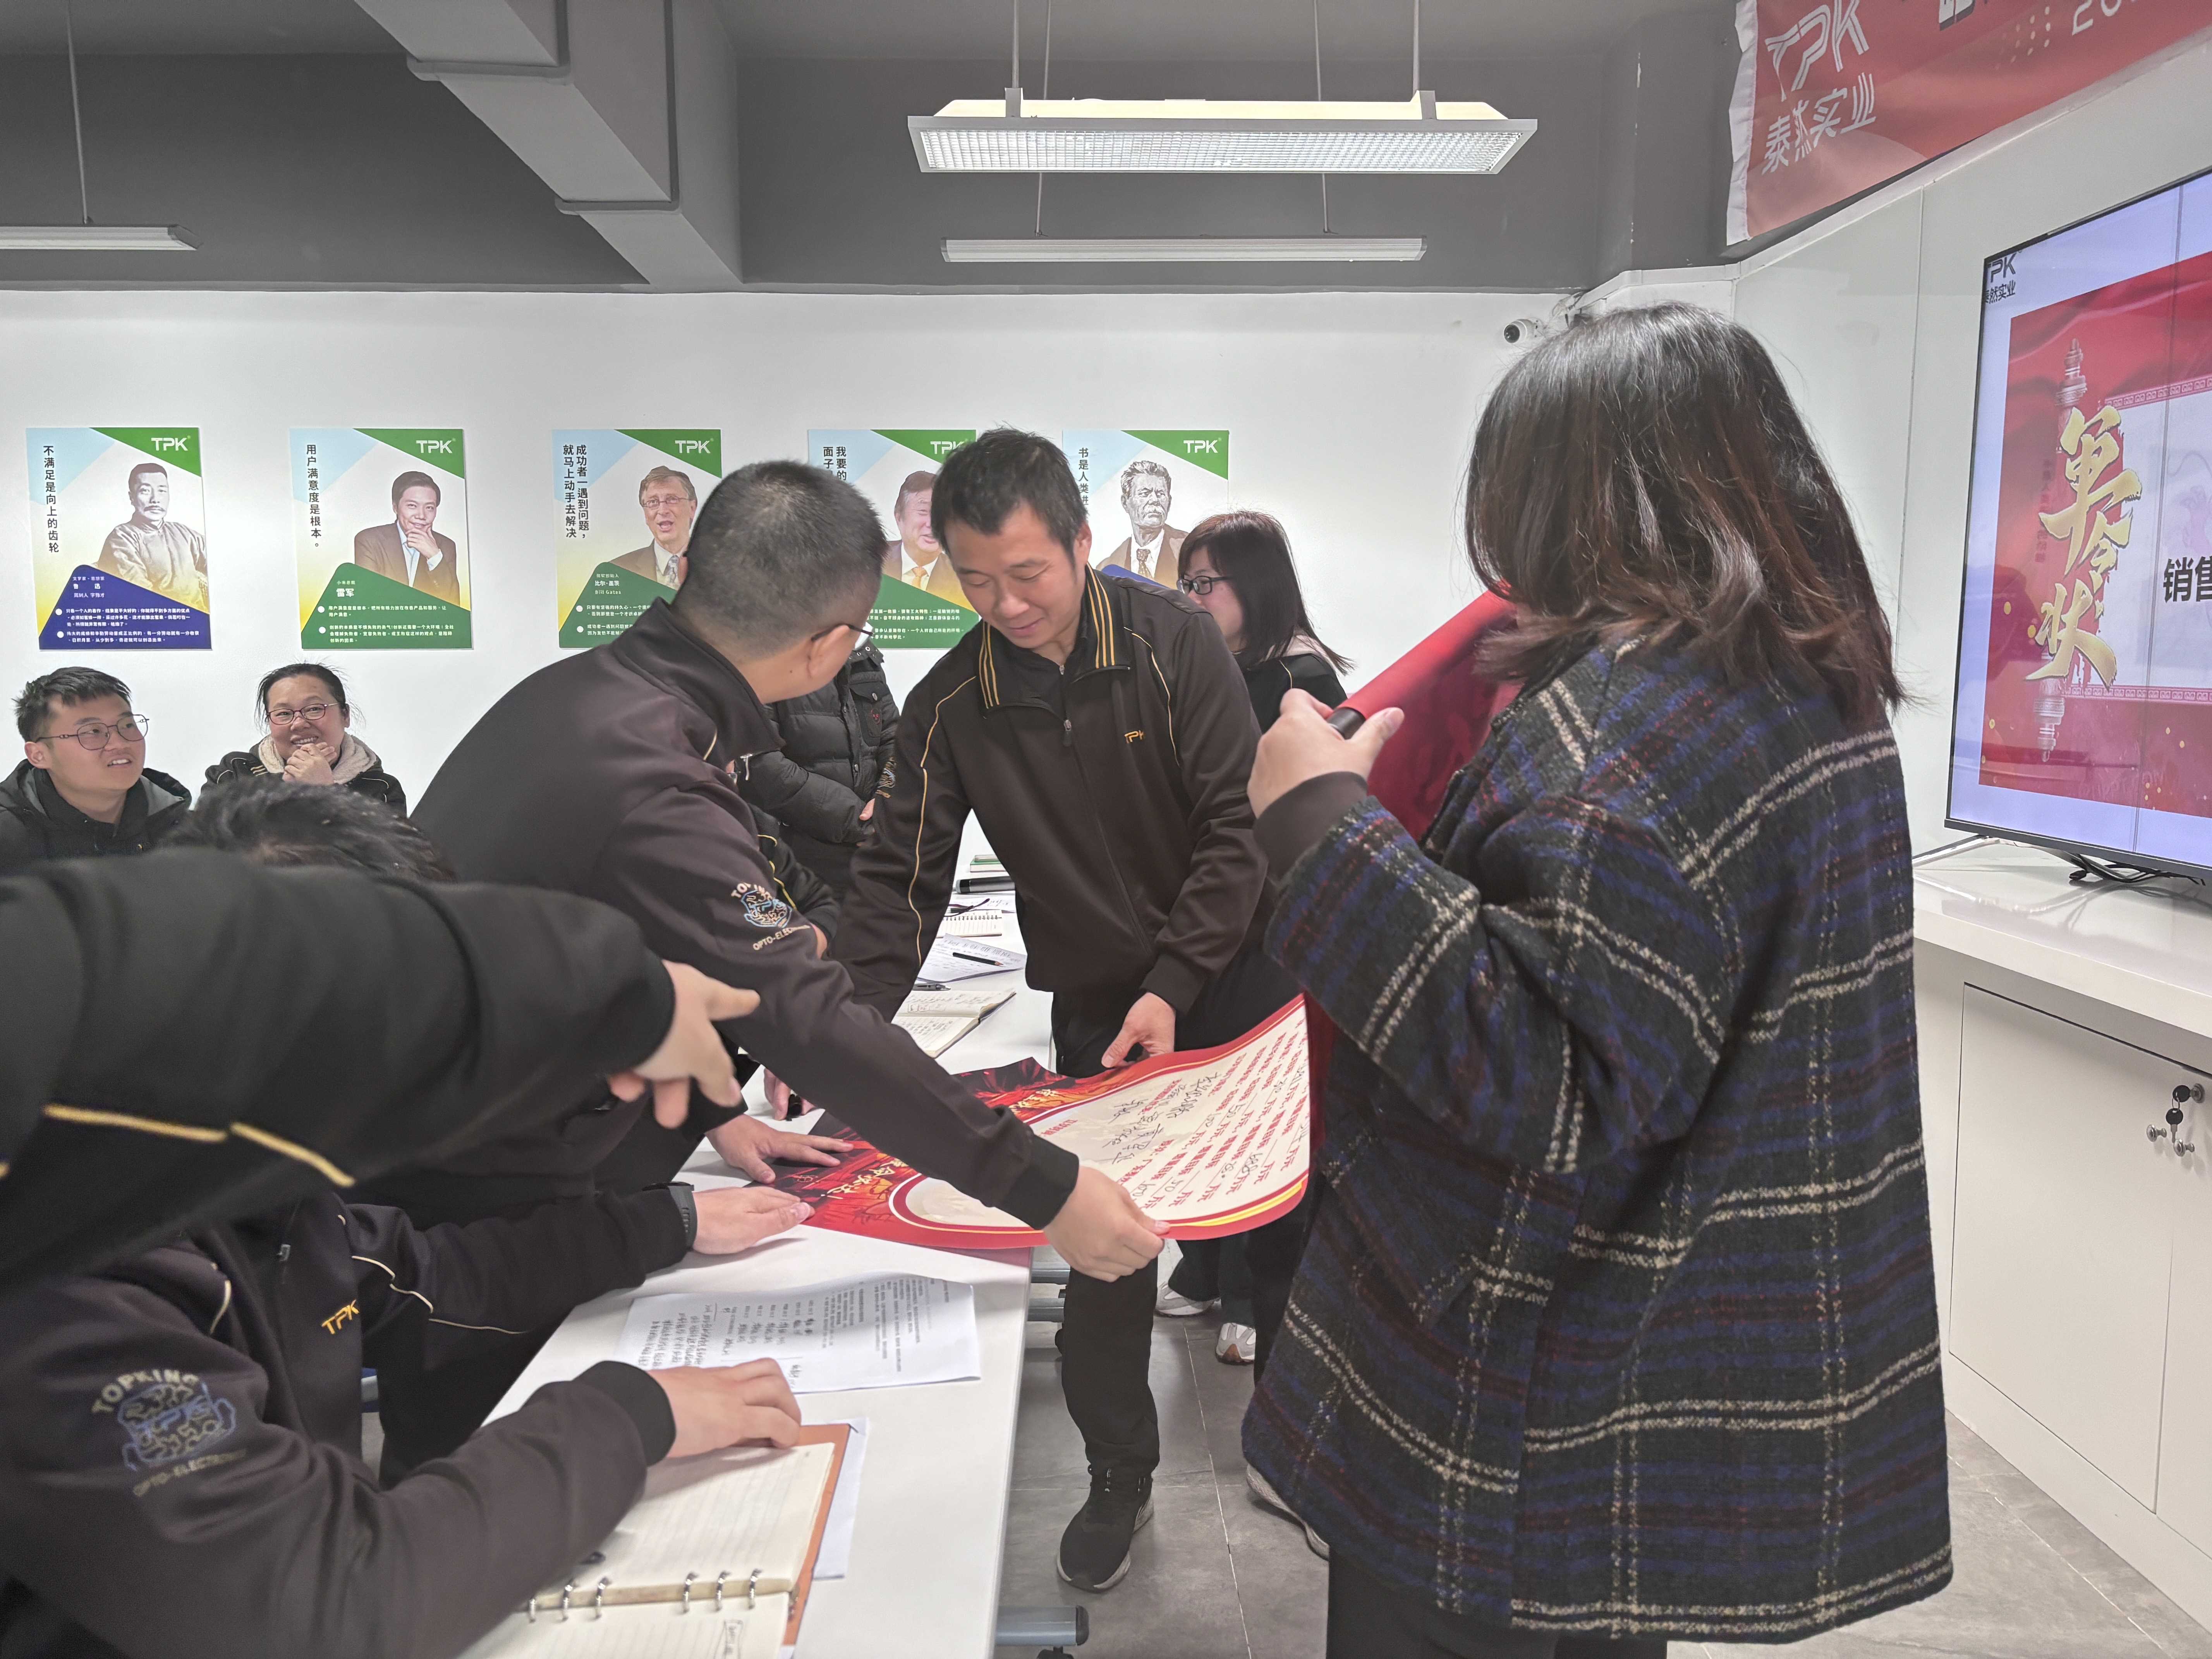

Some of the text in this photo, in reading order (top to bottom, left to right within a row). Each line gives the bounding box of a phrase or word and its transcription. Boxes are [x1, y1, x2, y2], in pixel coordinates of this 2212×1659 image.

[1765, 0, 1869, 101] TPK
[1762, 72, 1876, 175] 泰然实业
[1987, 252, 2017, 283] PK
[151, 438, 188, 451] TPK
[416, 440, 452, 454] TPK
[675, 440, 711, 454] TPK
[1183, 440, 1218, 453] TPK
[823, 447, 833, 474] 面子
[43, 445, 59, 553] 不满足是向上的齿轮
[306, 444, 322, 547] 用户满意度是根本。
[563, 444, 577, 538] 就马上动手去解决
[336, 588, 354, 597] 雷军
[321, 1300, 359, 1334] TPK
